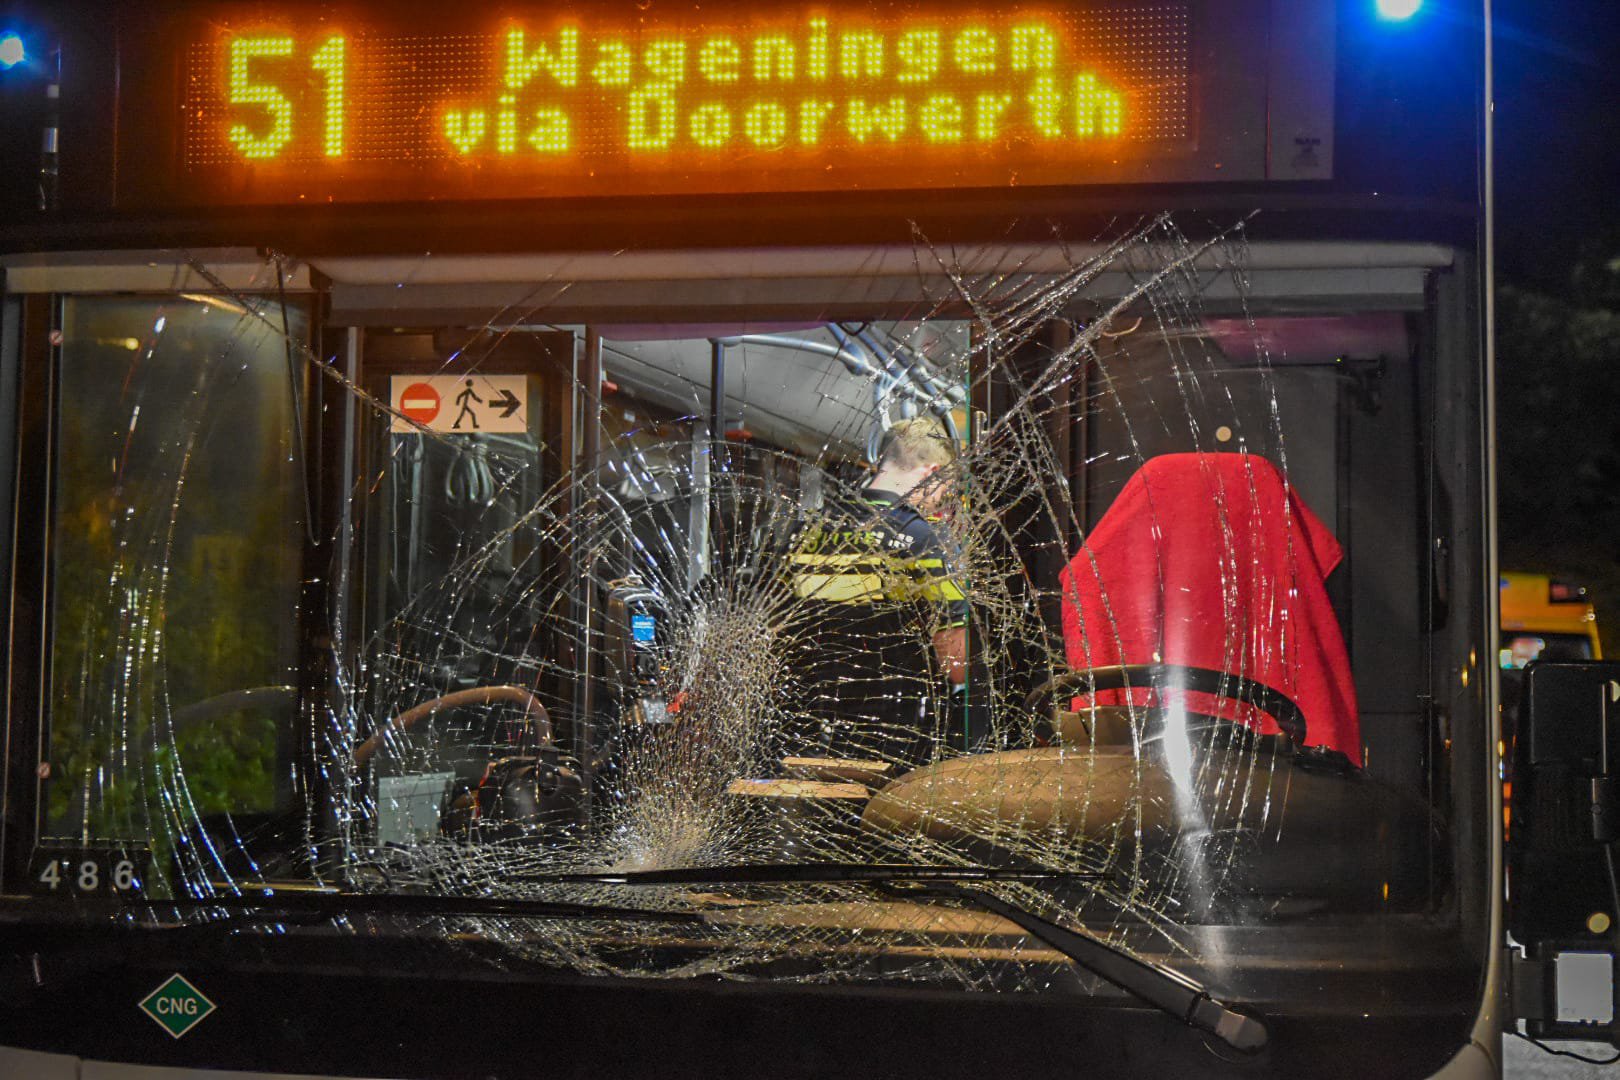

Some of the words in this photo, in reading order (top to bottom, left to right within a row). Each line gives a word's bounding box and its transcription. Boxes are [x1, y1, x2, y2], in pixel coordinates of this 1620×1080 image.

[504, 17, 1055, 89] Wageningen
[229, 35, 346, 158] 51
[443, 93, 570, 153] via
[627, 73, 1122, 150] Doorwerth
[156, 997, 198, 1015] CNG
